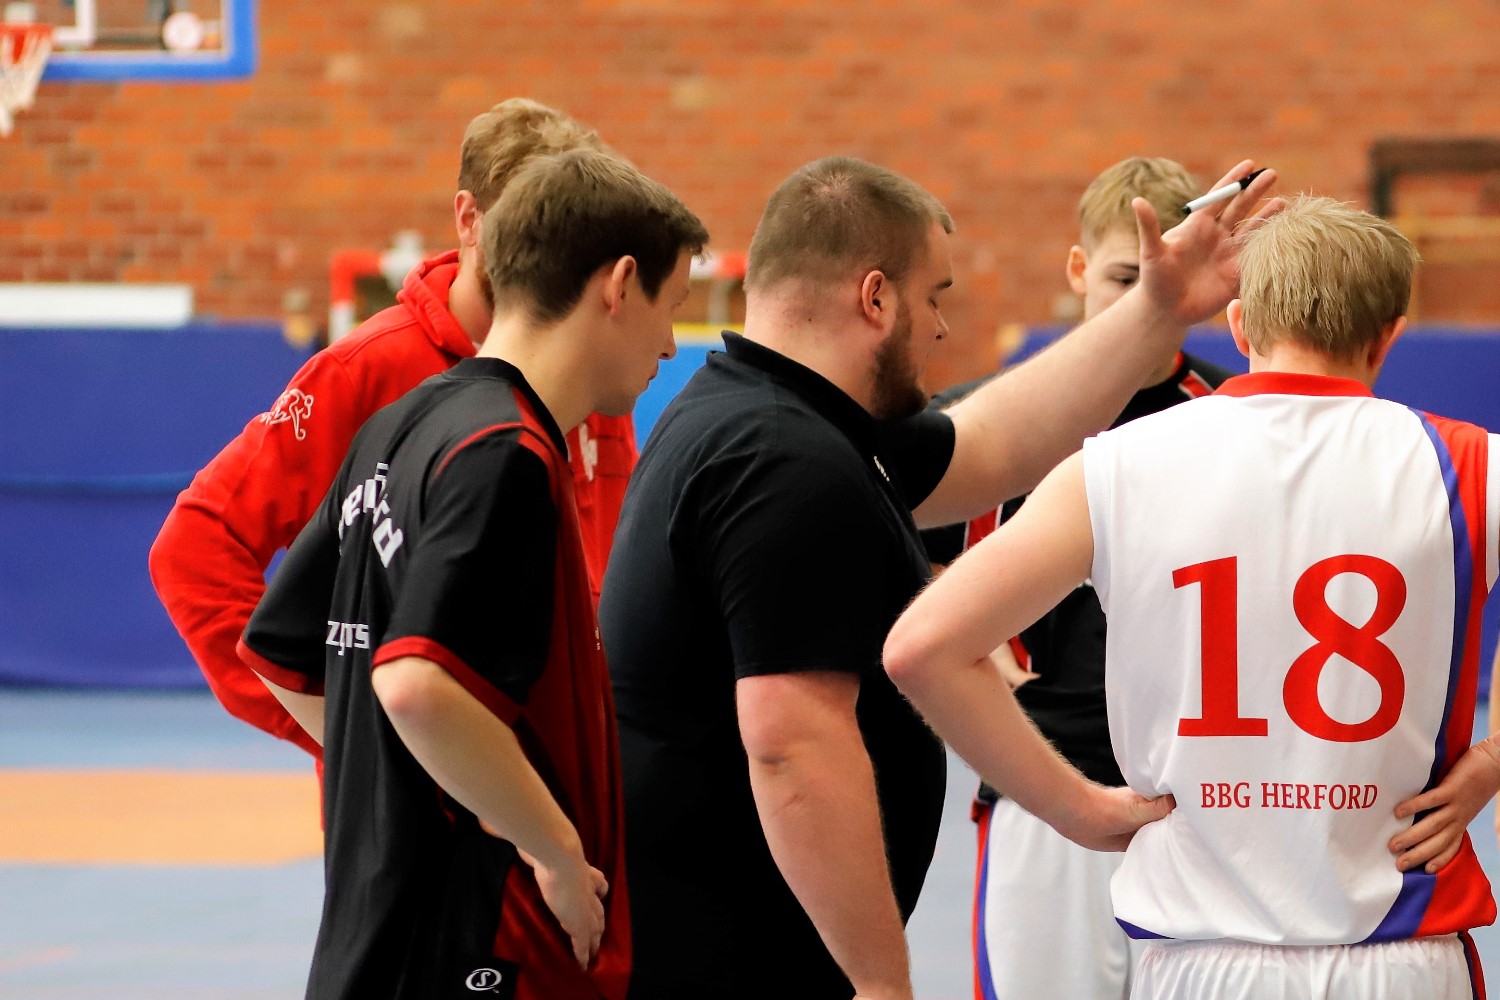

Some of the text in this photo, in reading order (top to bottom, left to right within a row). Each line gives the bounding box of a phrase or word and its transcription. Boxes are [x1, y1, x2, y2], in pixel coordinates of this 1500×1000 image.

[1171, 554, 1408, 743] 18
[1200, 782, 1378, 811] BBG HERFORD
